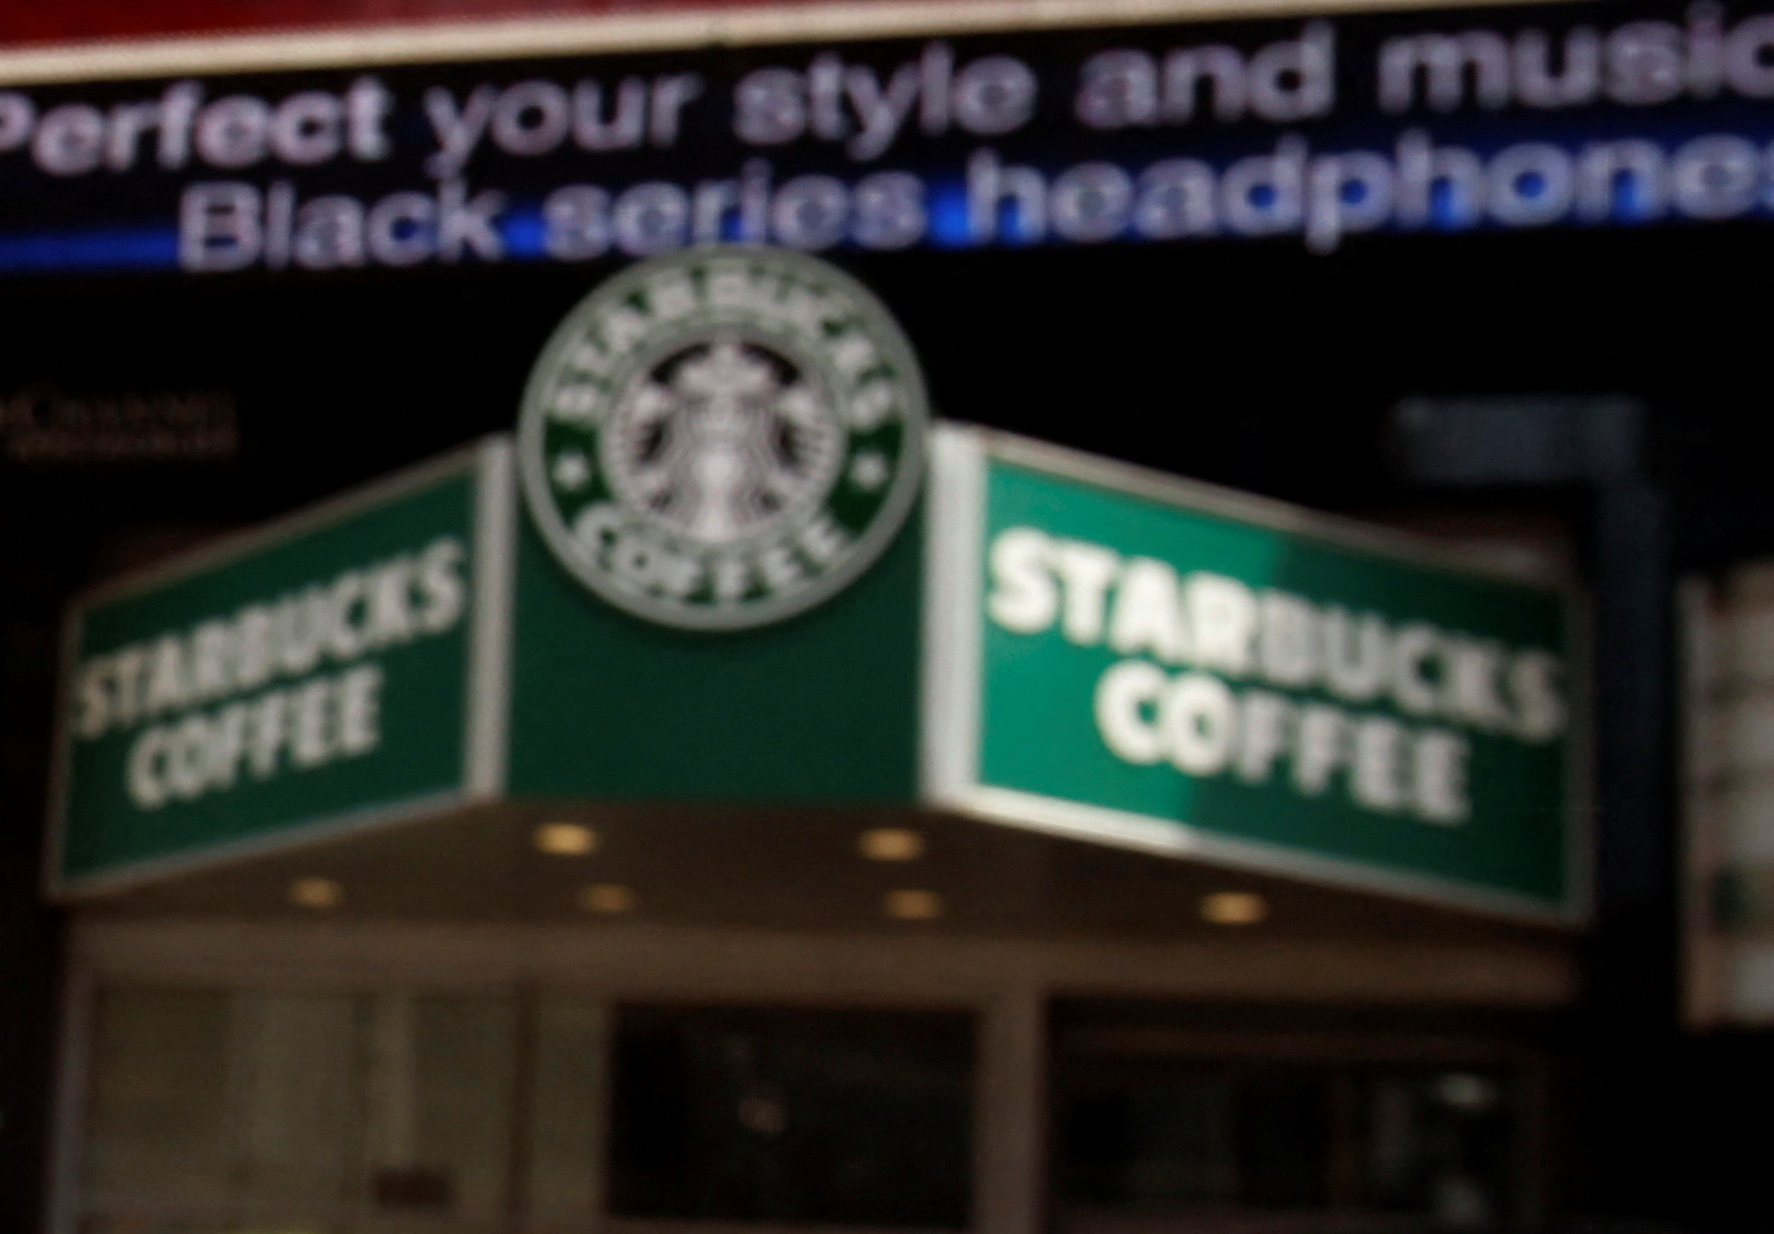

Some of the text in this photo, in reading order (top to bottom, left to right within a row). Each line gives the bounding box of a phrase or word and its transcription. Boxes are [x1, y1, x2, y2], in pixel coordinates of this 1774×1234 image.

[424, 72, 702, 180] your
[731, 41, 1038, 162] style
[1074, 20, 1338, 129] and
[1376, 1, 1774, 114] music
[177, 130, 1774, 274] Black series headphone
[548, 263, 898, 433] STARBUCKS
[573, 501, 849, 603] COFFEE
[987, 525, 1566, 744] STARBUCKS
[73, 535, 468, 740] STARBUCKS
[128, 661, 384, 810] COFFEE
[1093, 659, 1471, 824] COFFEE
